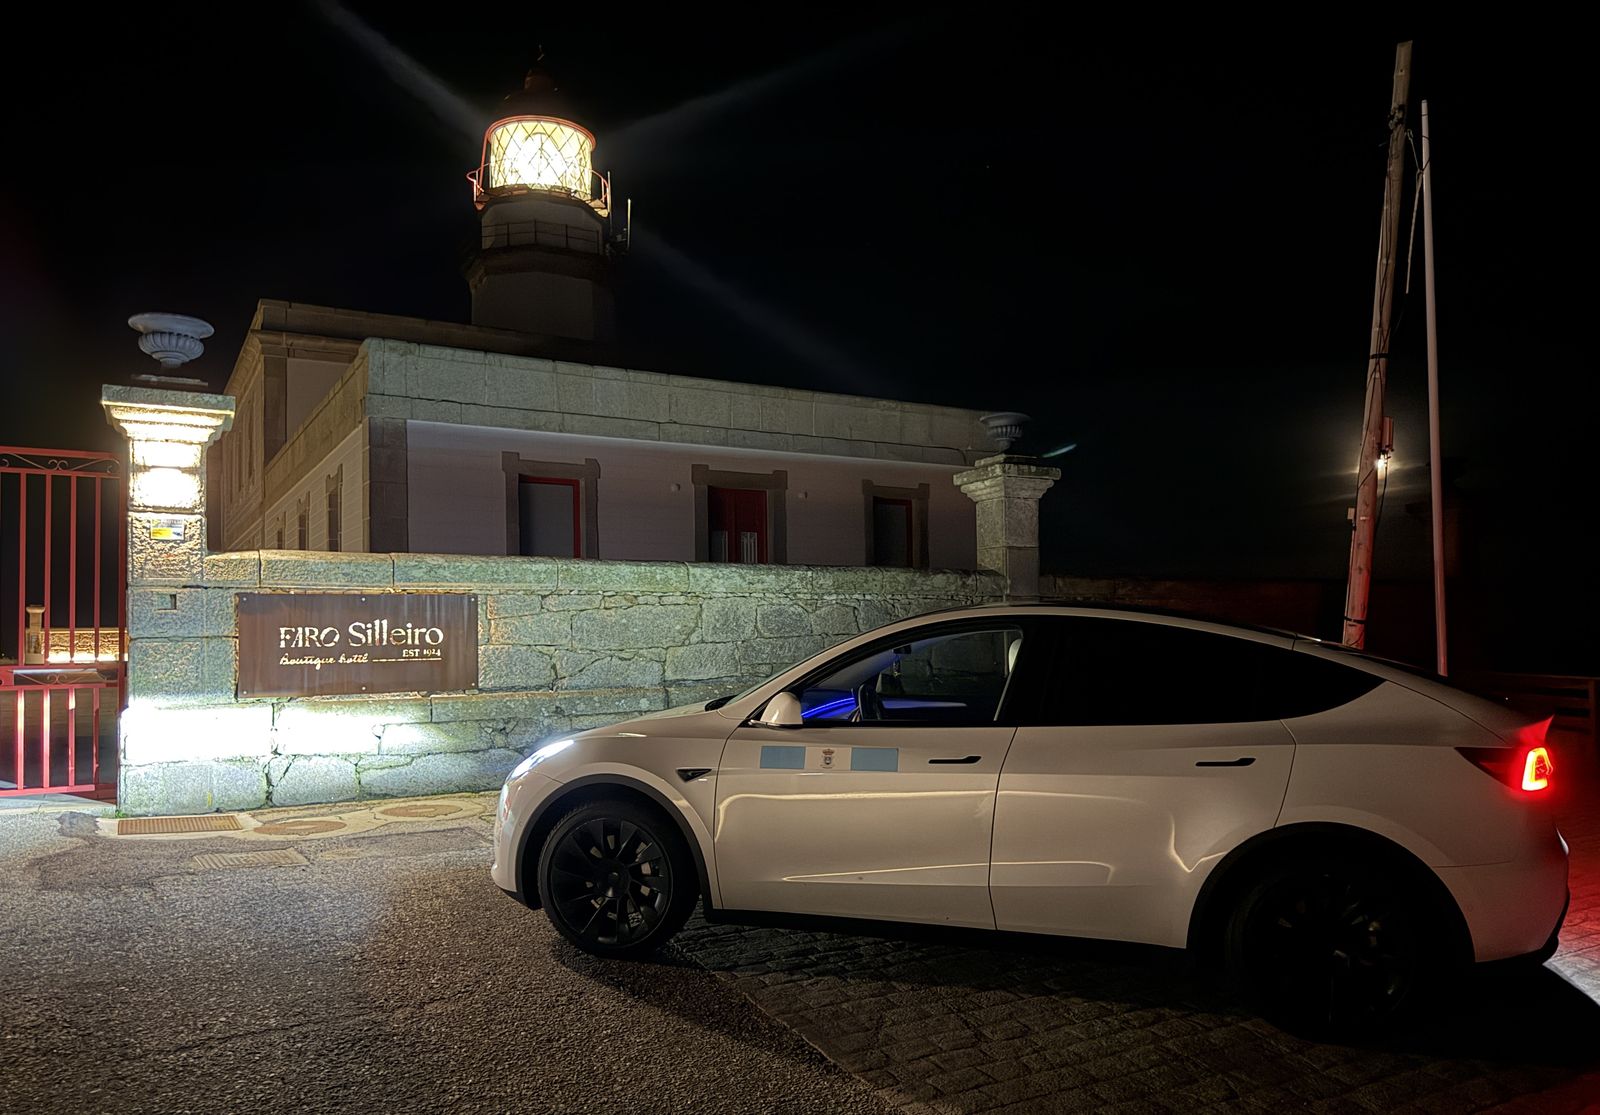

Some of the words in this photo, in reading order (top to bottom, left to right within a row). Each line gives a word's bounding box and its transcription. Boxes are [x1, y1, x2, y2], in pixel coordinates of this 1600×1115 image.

[279, 626, 340, 648] FARO
[348, 619, 444, 647] Silleiro
[402, 648, 420, 657] EST
